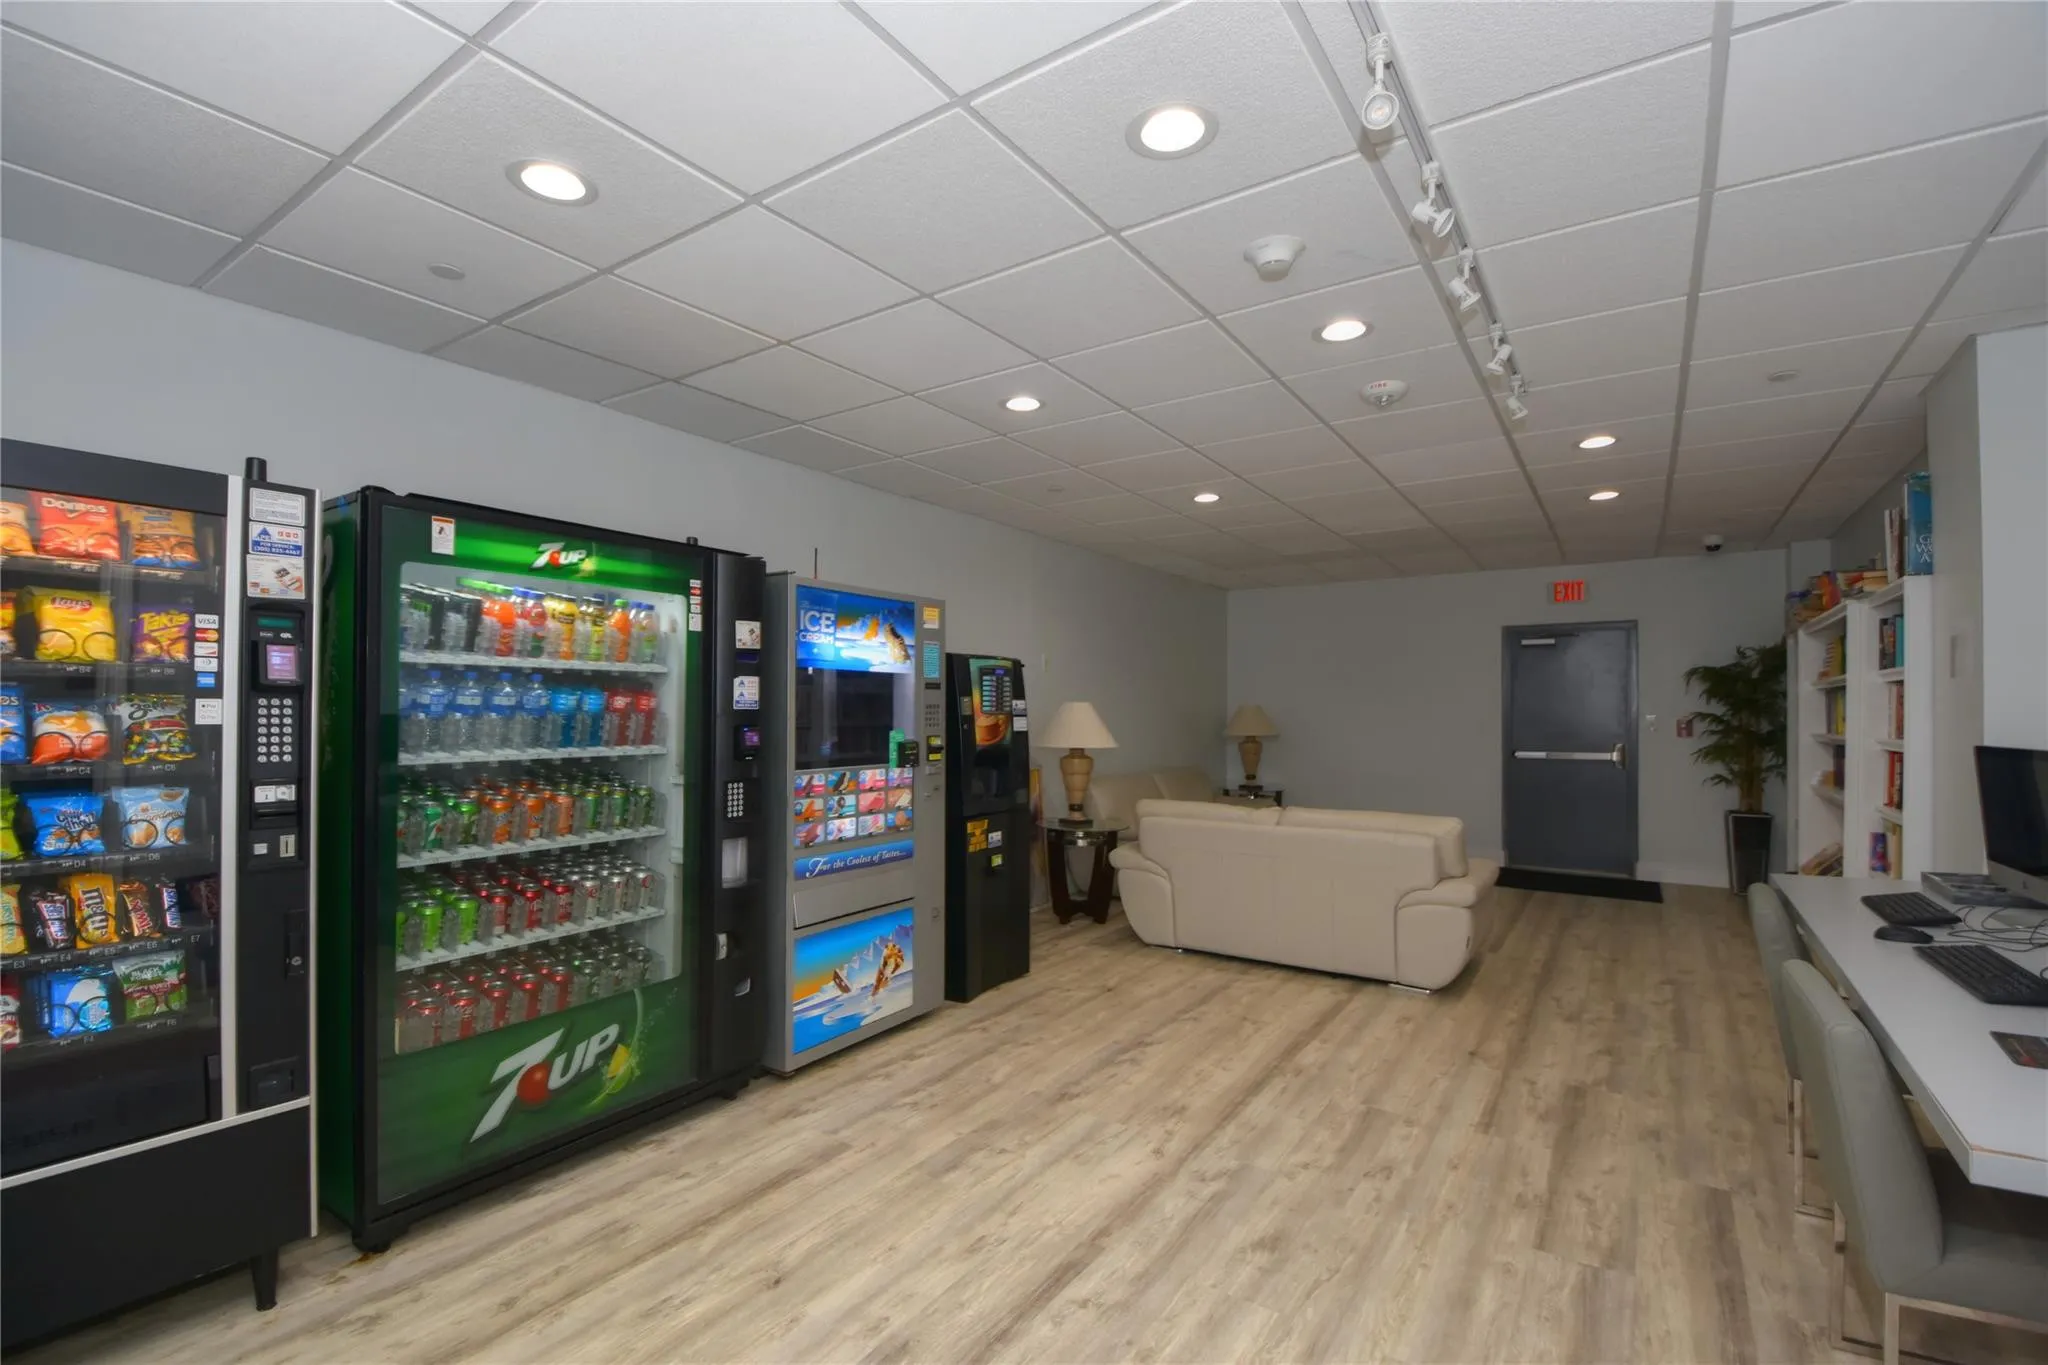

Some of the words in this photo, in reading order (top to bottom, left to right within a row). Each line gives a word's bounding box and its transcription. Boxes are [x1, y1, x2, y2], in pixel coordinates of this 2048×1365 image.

[1553, 580, 1584, 602] EXIT
[198, 617, 217, 625] VISA
[799, 610, 836, 633] ICE
[469, 1023, 620, 1143] 7UP
